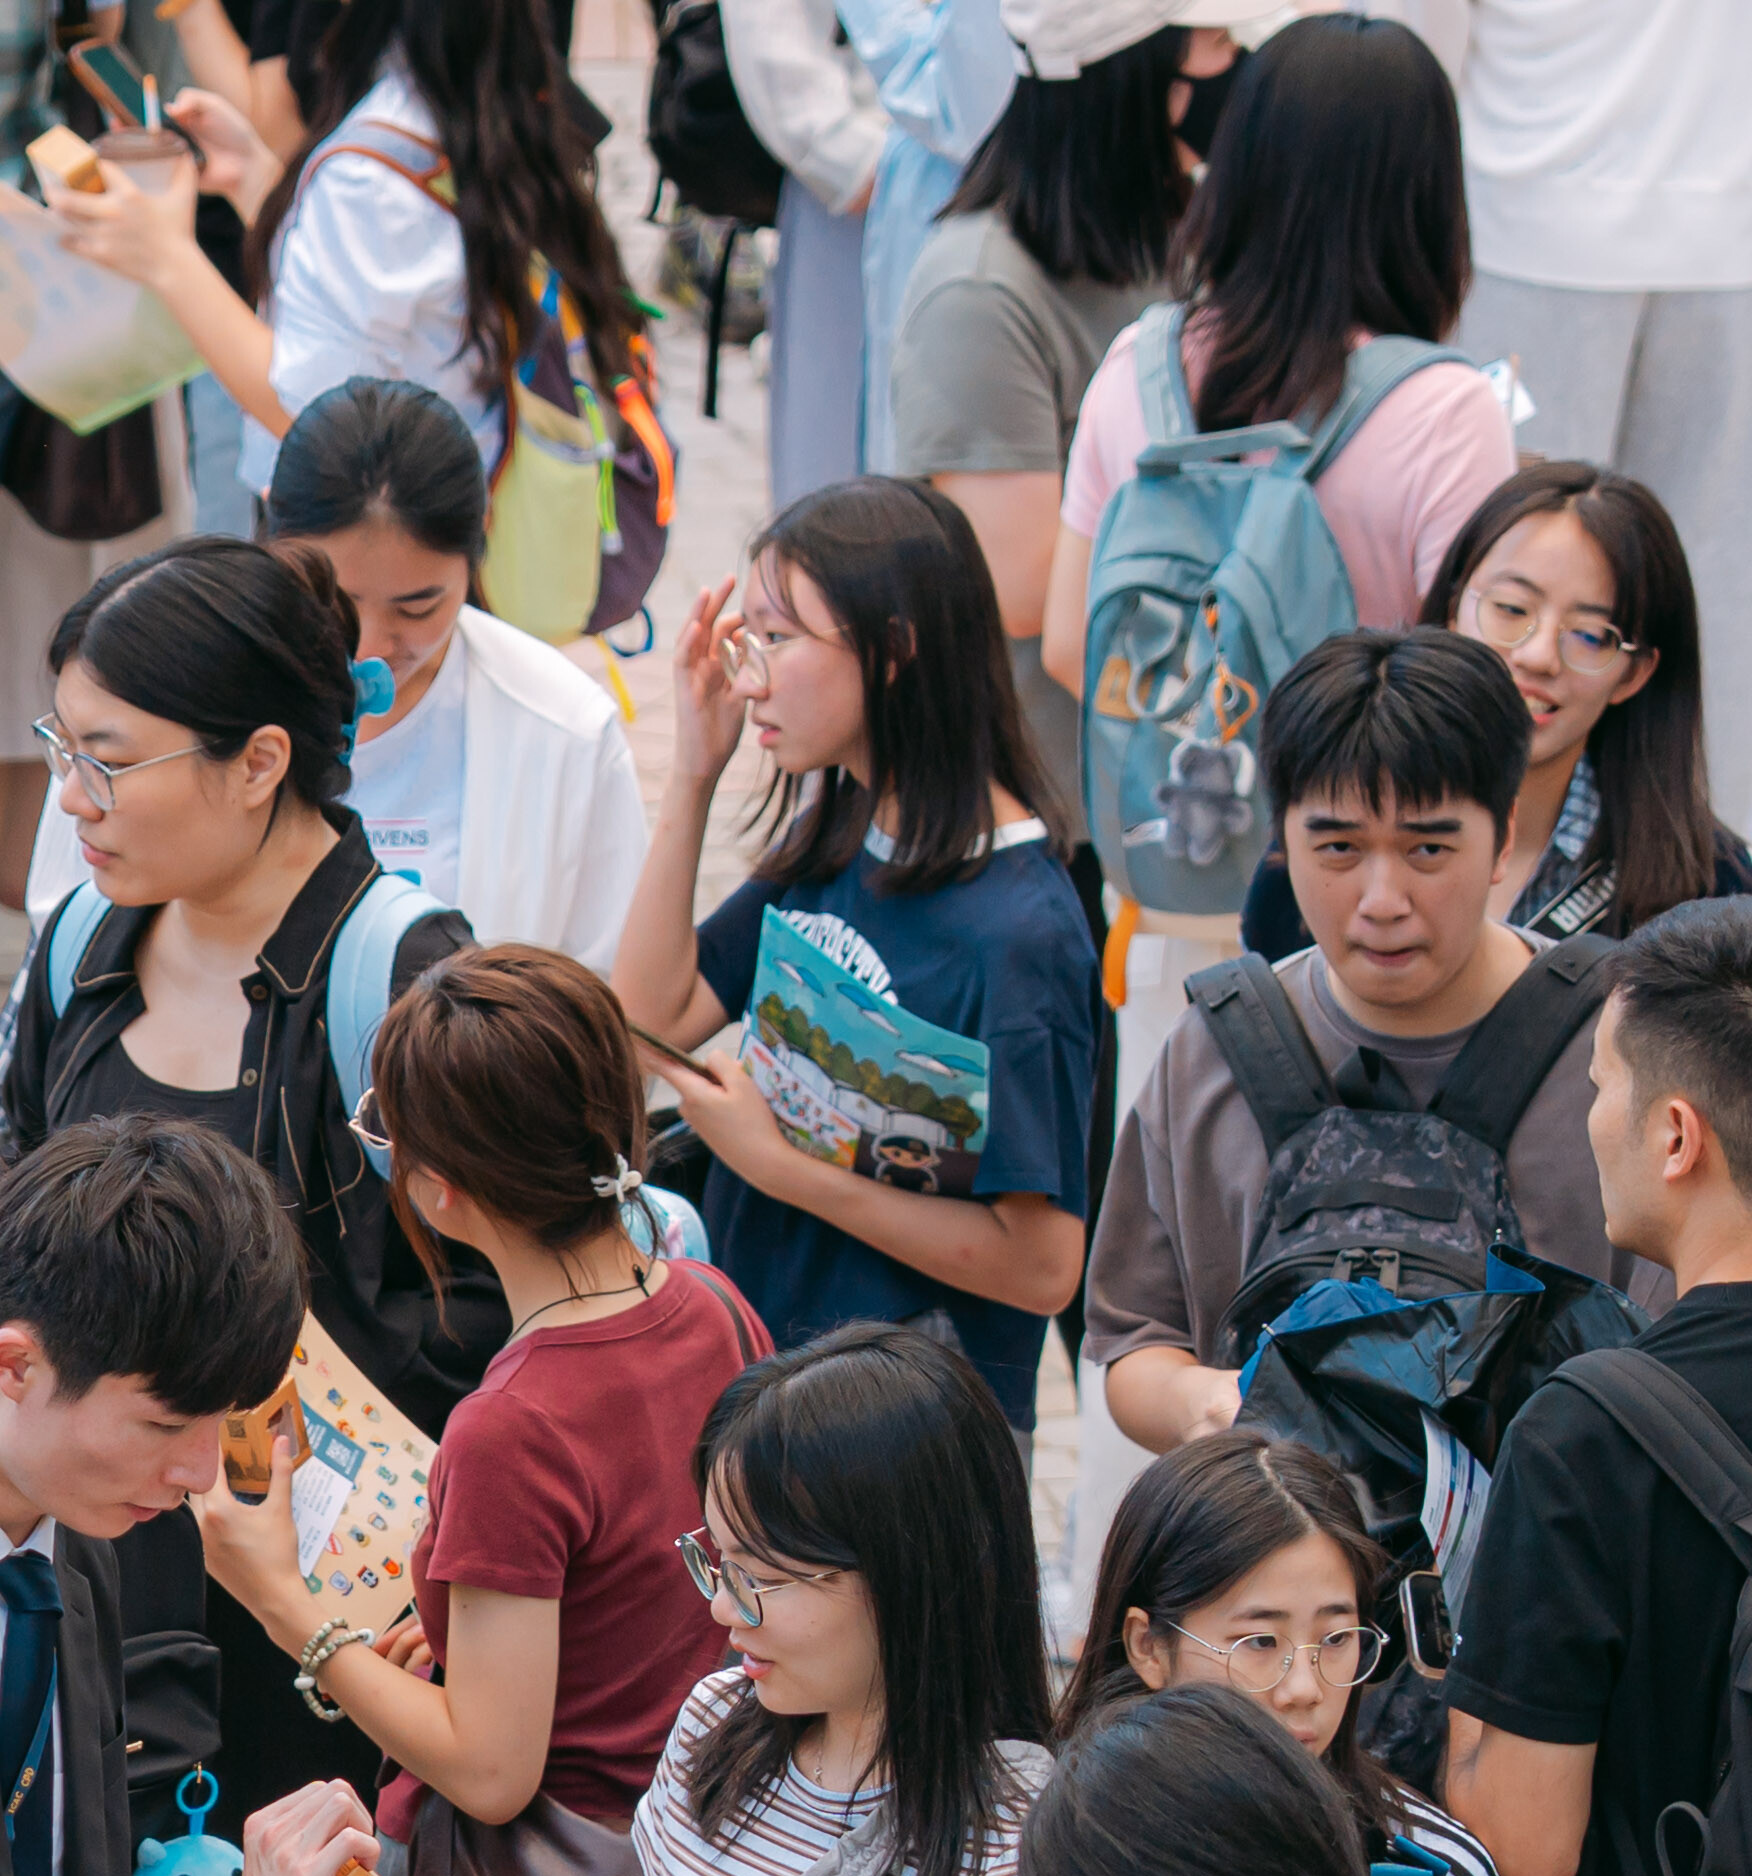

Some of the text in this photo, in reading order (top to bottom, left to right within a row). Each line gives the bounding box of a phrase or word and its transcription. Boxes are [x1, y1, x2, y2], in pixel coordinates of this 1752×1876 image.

[368, 829, 430, 847] IVENS
[7, 1766, 36, 1816] ICAC CPD
